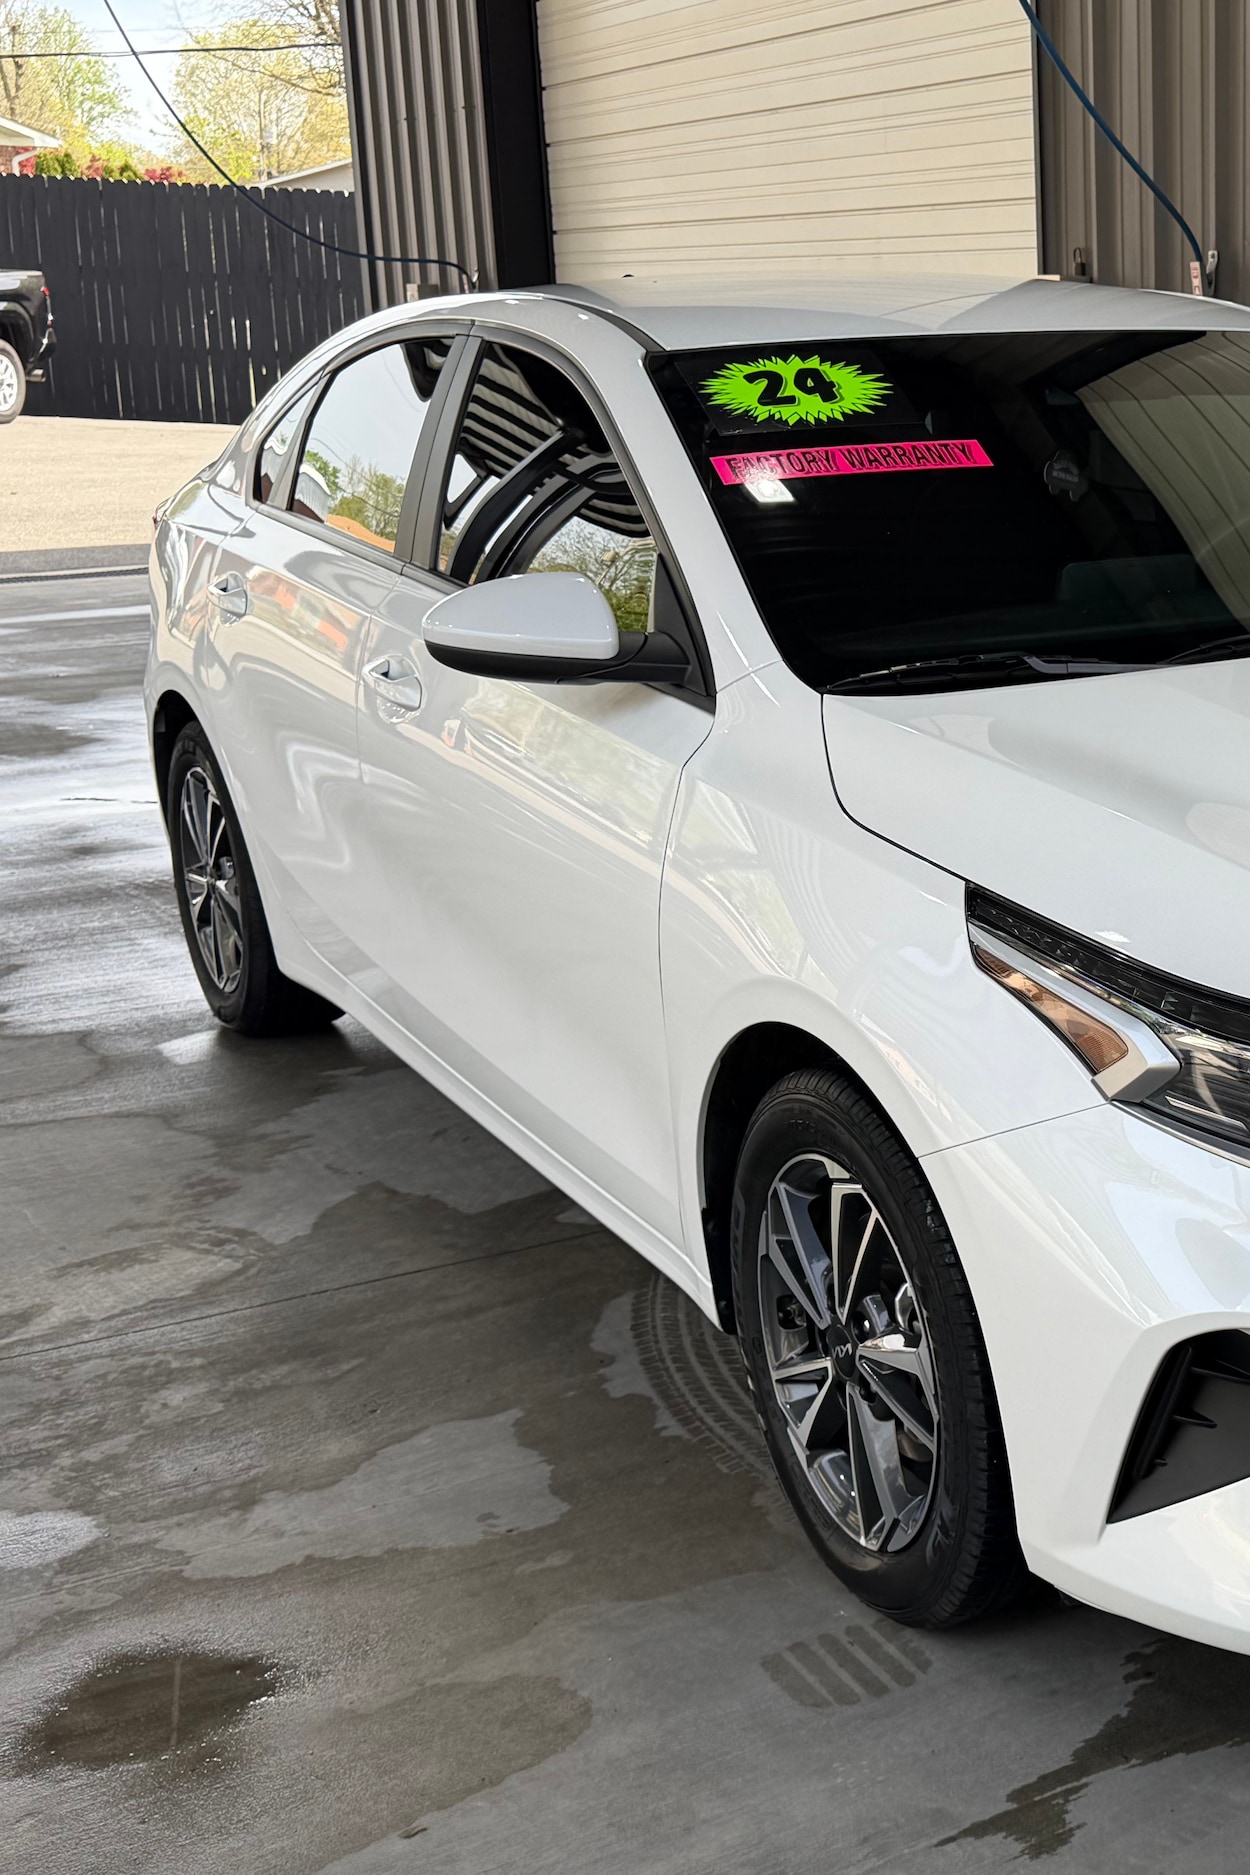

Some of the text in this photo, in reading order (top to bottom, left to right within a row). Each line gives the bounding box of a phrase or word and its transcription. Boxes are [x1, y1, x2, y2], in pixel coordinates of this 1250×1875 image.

[743, 367, 843, 407] 24
[725, 442, 976, 479] FACTORY WARRANTY
